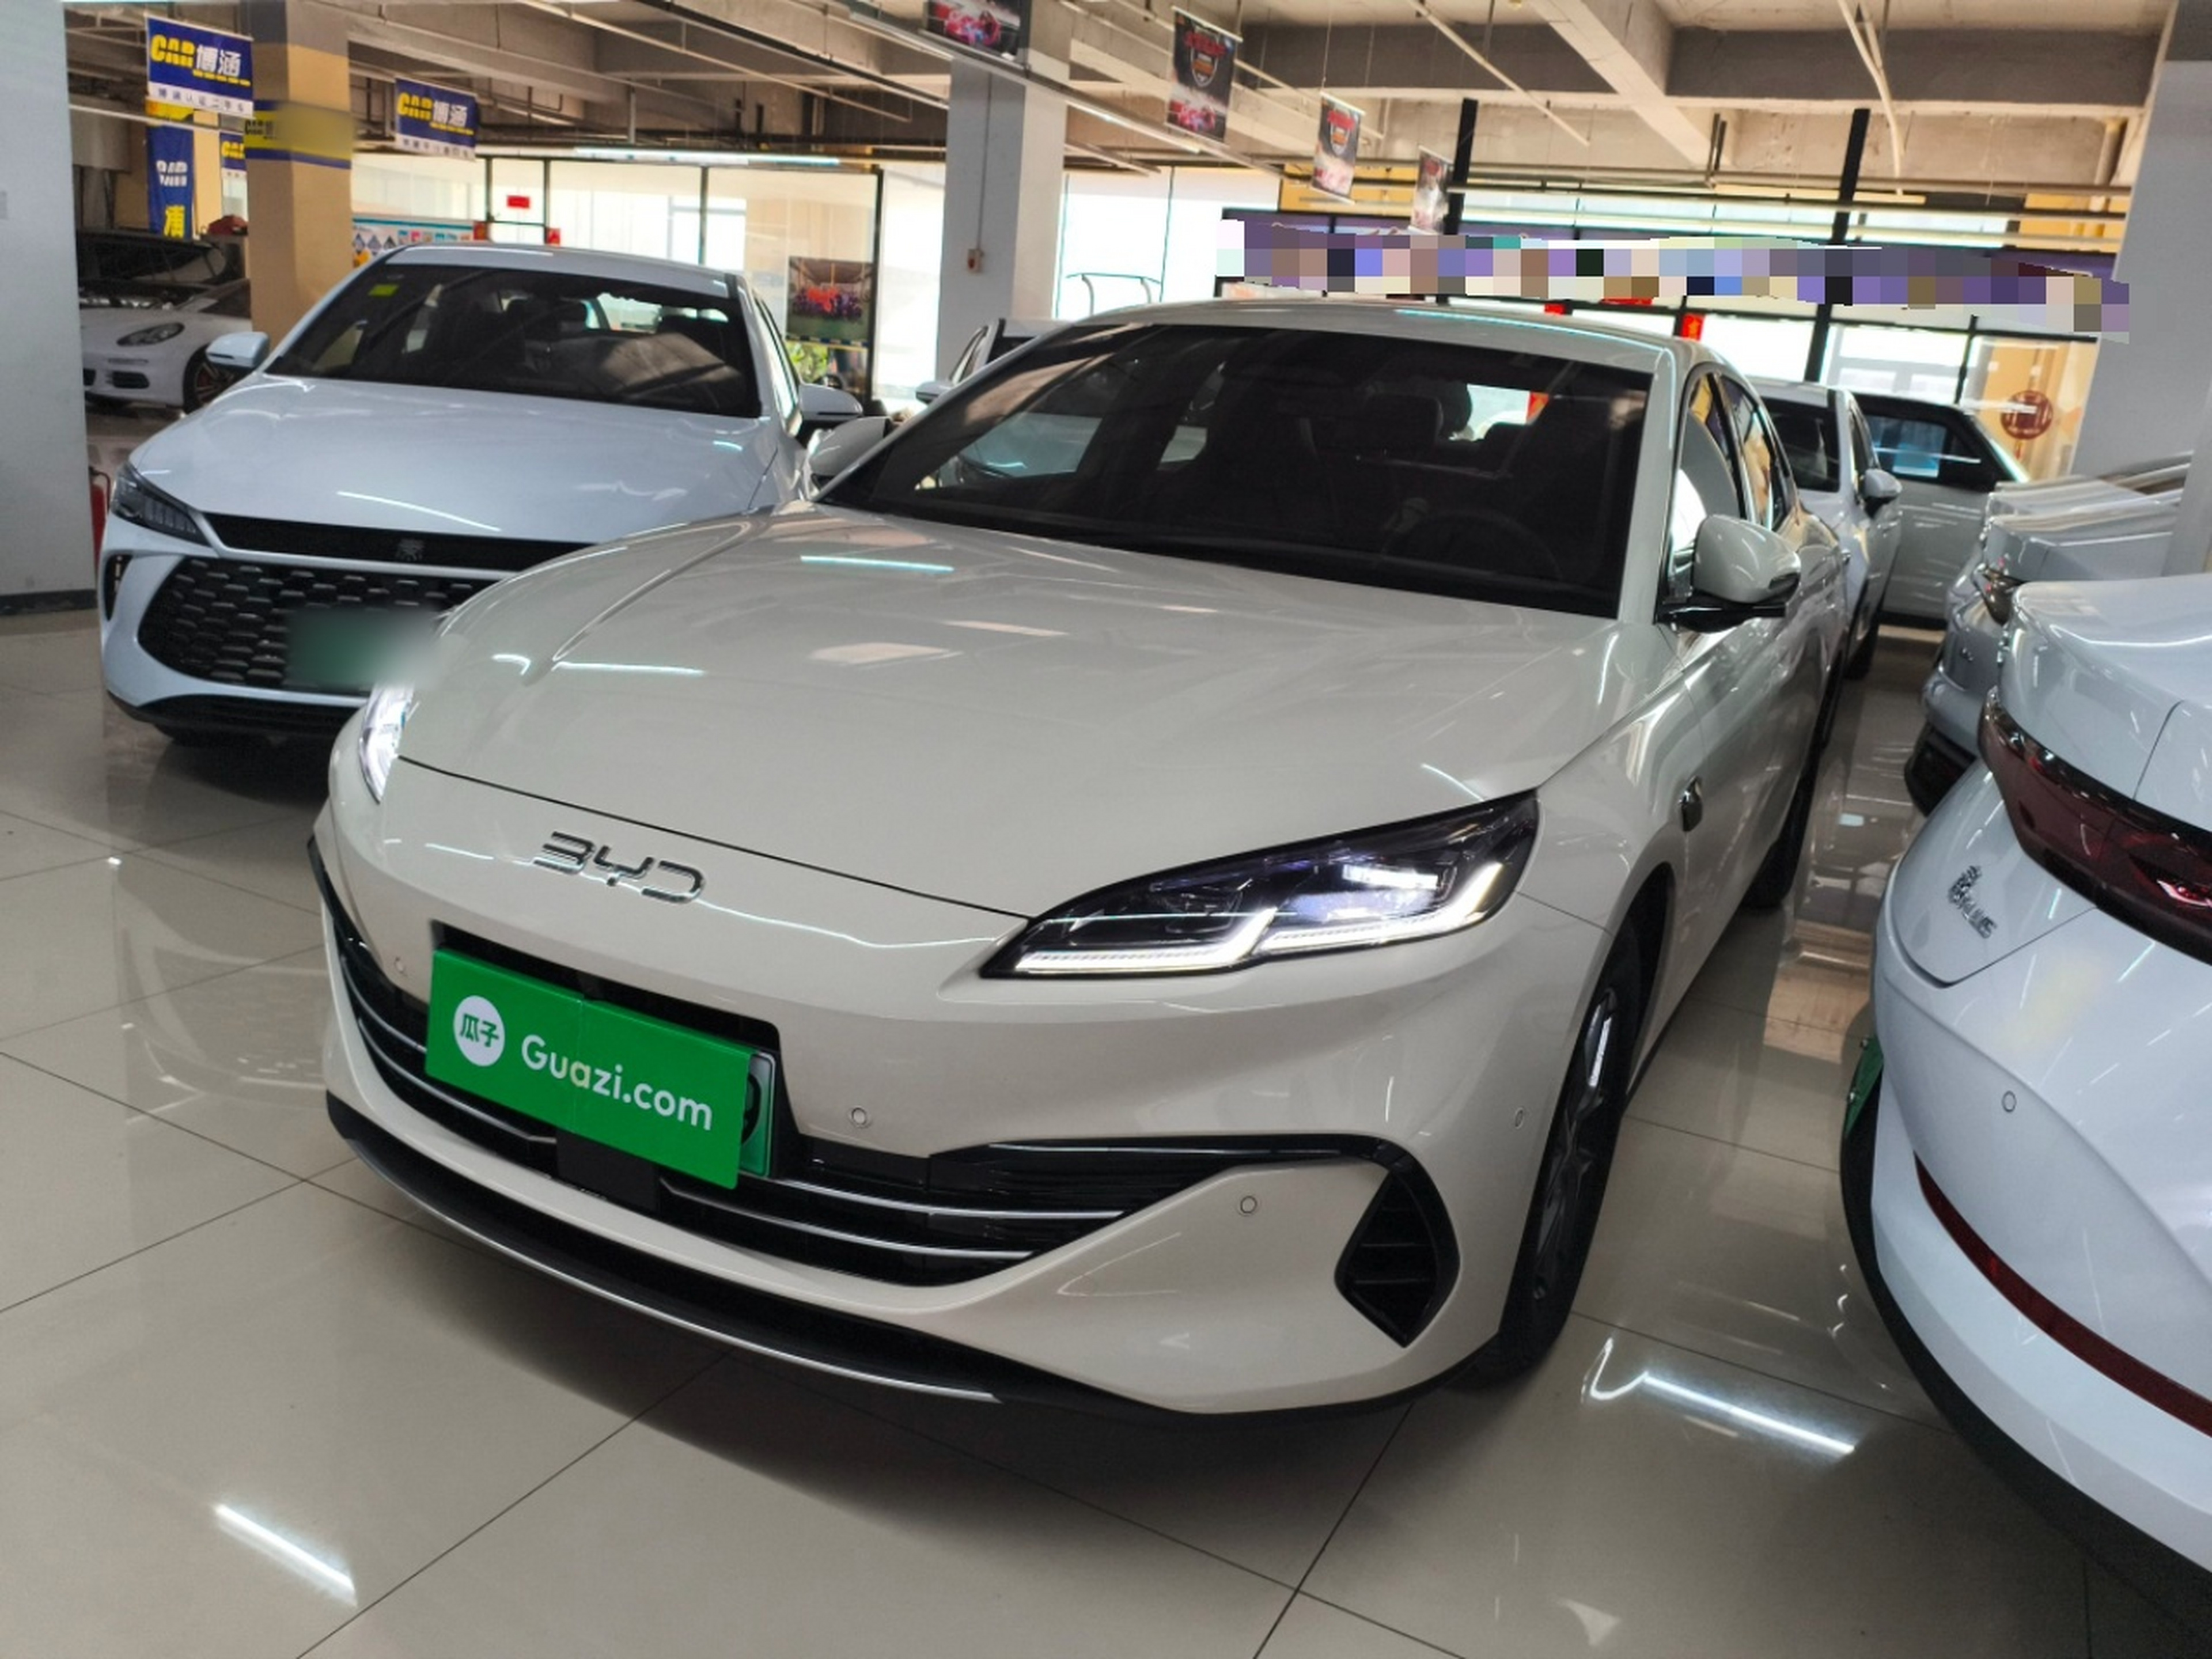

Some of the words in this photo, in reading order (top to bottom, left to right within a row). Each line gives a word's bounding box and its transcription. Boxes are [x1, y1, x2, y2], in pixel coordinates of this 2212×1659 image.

[151, 35, 195, 69] CAR
[397, 92, 433, 121] CAR
[533, 831, 704, 904] BYD
[460, 1013, 499, 1048] 瓜子
[521, 1035, 713, 1131] Guazi.com
